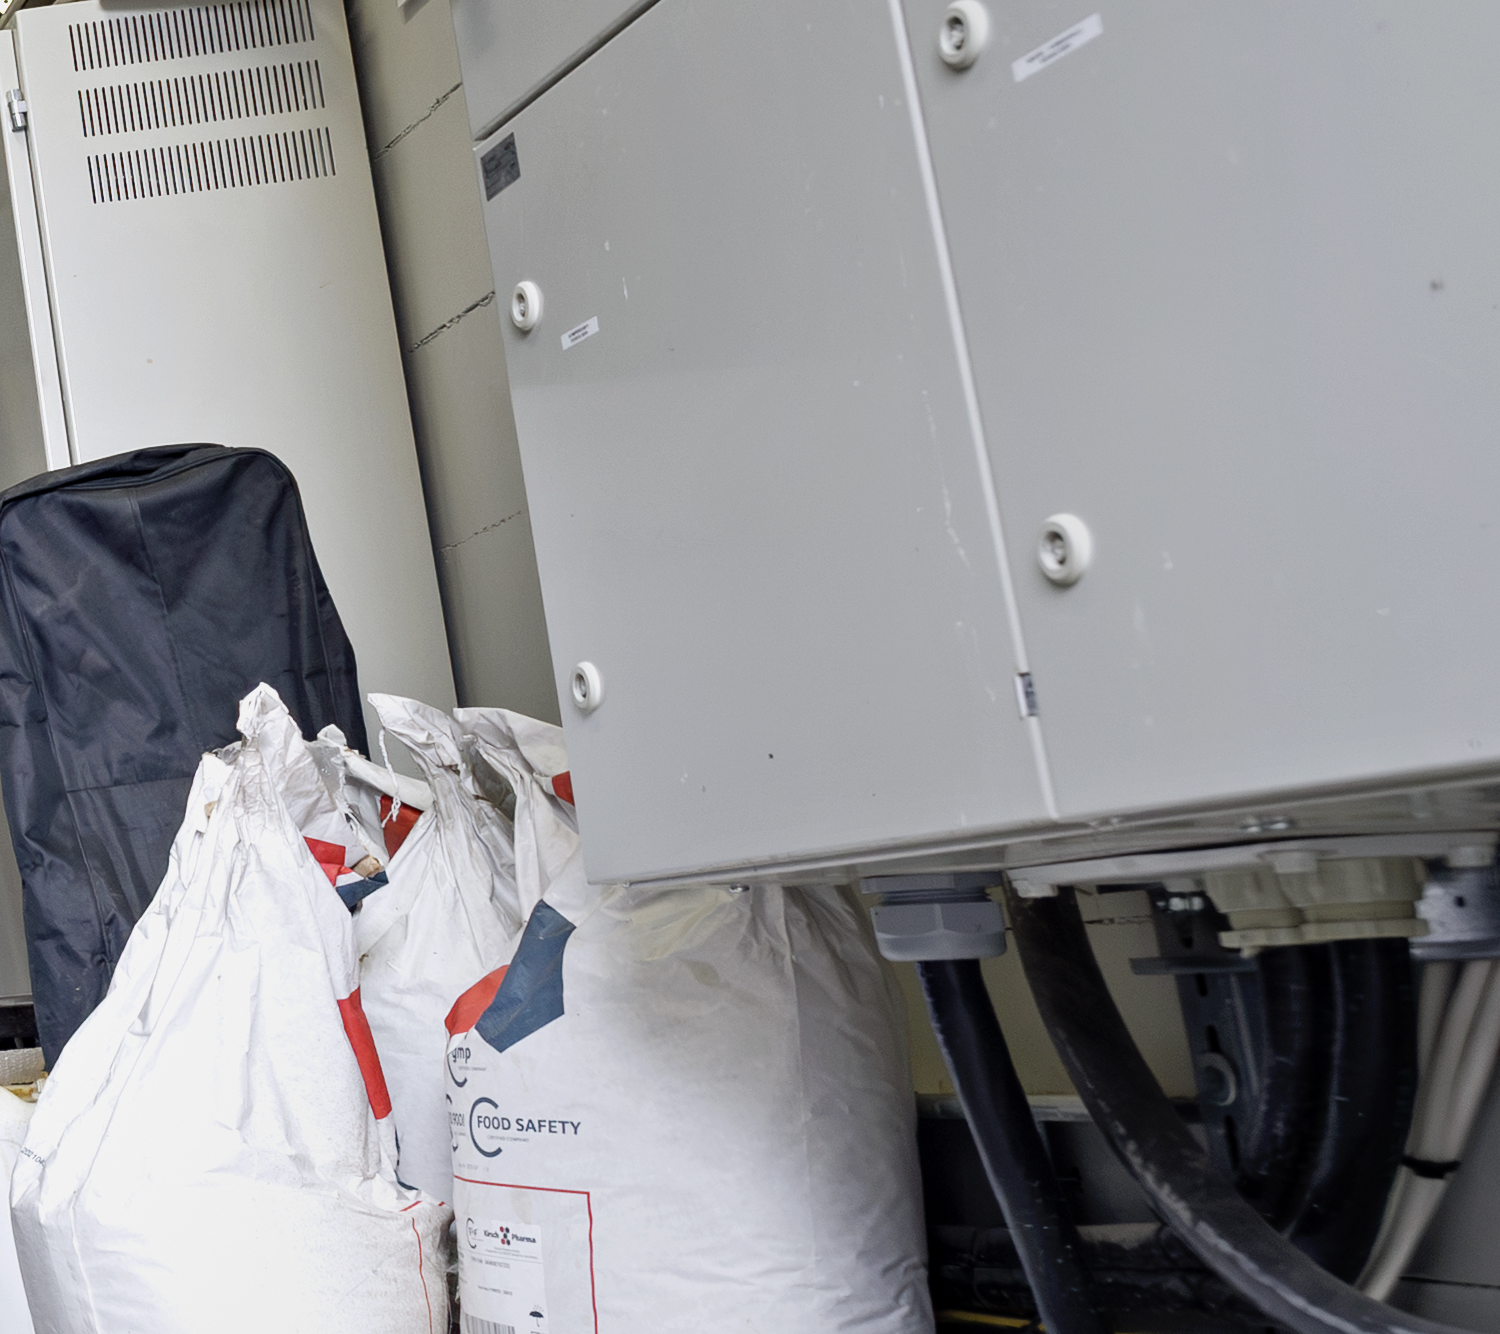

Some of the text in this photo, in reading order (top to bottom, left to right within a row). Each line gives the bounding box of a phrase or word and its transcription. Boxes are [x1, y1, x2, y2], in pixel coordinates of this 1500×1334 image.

[477, 1115, 581, 1136] FOOD SAFETY
[511, 1233, 537, 1244] Pharma
